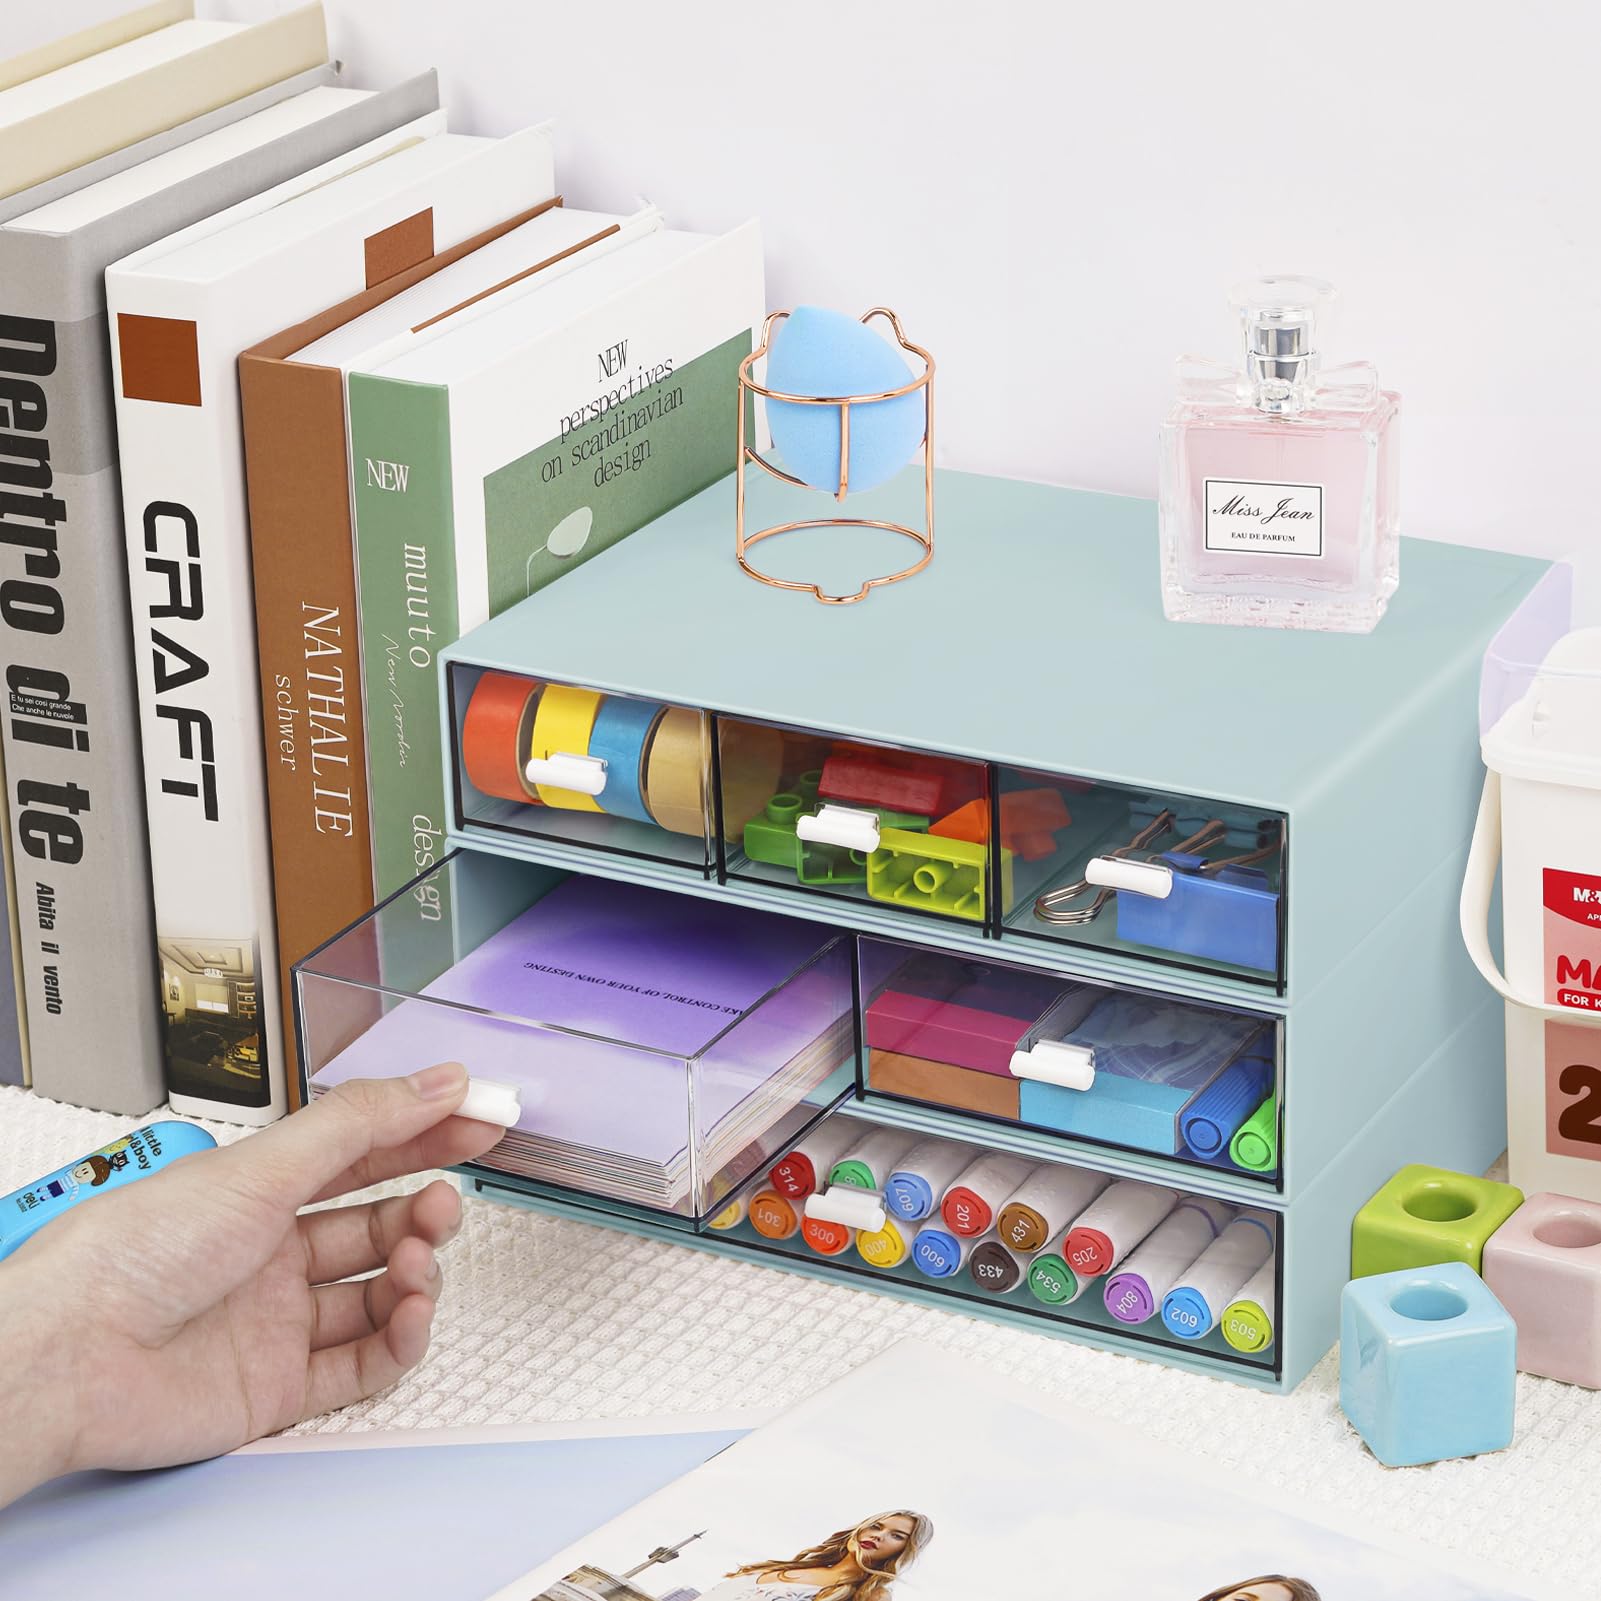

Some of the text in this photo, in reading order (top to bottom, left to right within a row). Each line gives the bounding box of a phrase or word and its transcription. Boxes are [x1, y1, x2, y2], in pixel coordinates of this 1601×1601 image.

[598, 339, 628, 383] NEW
[560, 358, 673, 444] perspectives
[541, 386, 684, 483] on scandinavian
[365, 457, 410, 493] NEW
[594, 439, 651, 488] design
[1212, 494, 1316, 525] Miss Jean
[1262, 534, 1296, 542] PARFUM
[404, 542, 437, 668] muuto
[143, 501, 219, 822] CRAFT
[6, 664, 90, 752] di
[49, 702, 72, 710] grande
[275, 674, 299, 772] schwer
[302, 601, 354, 837] NATHALIE
[17, 780, 91, 865] te
[36, 881, 56, 931] Abita
[1587, 913, 1601, 921] AP
[41, 941, 60, 955] il
[43, 965, 63, 1015] vento
[576, 973, 606, 985] OWN
[607, 979, 641, 993] YOUR
[641, 987, 660, 998] OF
[664, 991, 721, 1011] CONTROL
[1564, 994, 1589, 1006] FOR
[1558, 1064, 1601, 1145] 2
[779, 1166, 799, 1193] 314
[23, 1192, 40, 1210] deli
[895, 1187, 914, 1213] 607
[757, 1207, 781, 1227] 301
[956, 1204, 970, 1229] 201
[809, 1223, 835, 1244] 300
[1011, 1219, 1031, 1243] 431
[921, 1244, 945, 1268] 600
[1073, 1247, 1098, 1266] 205
[978, 1263, 1004, 1278] 433
[1035, 1270, 1062, 1294] 534
[1115, 1291, 1138, 1314] 804
[1171, 1307, 1198, 1328] 602
[1229, 1319, 1257, 1340] 503
